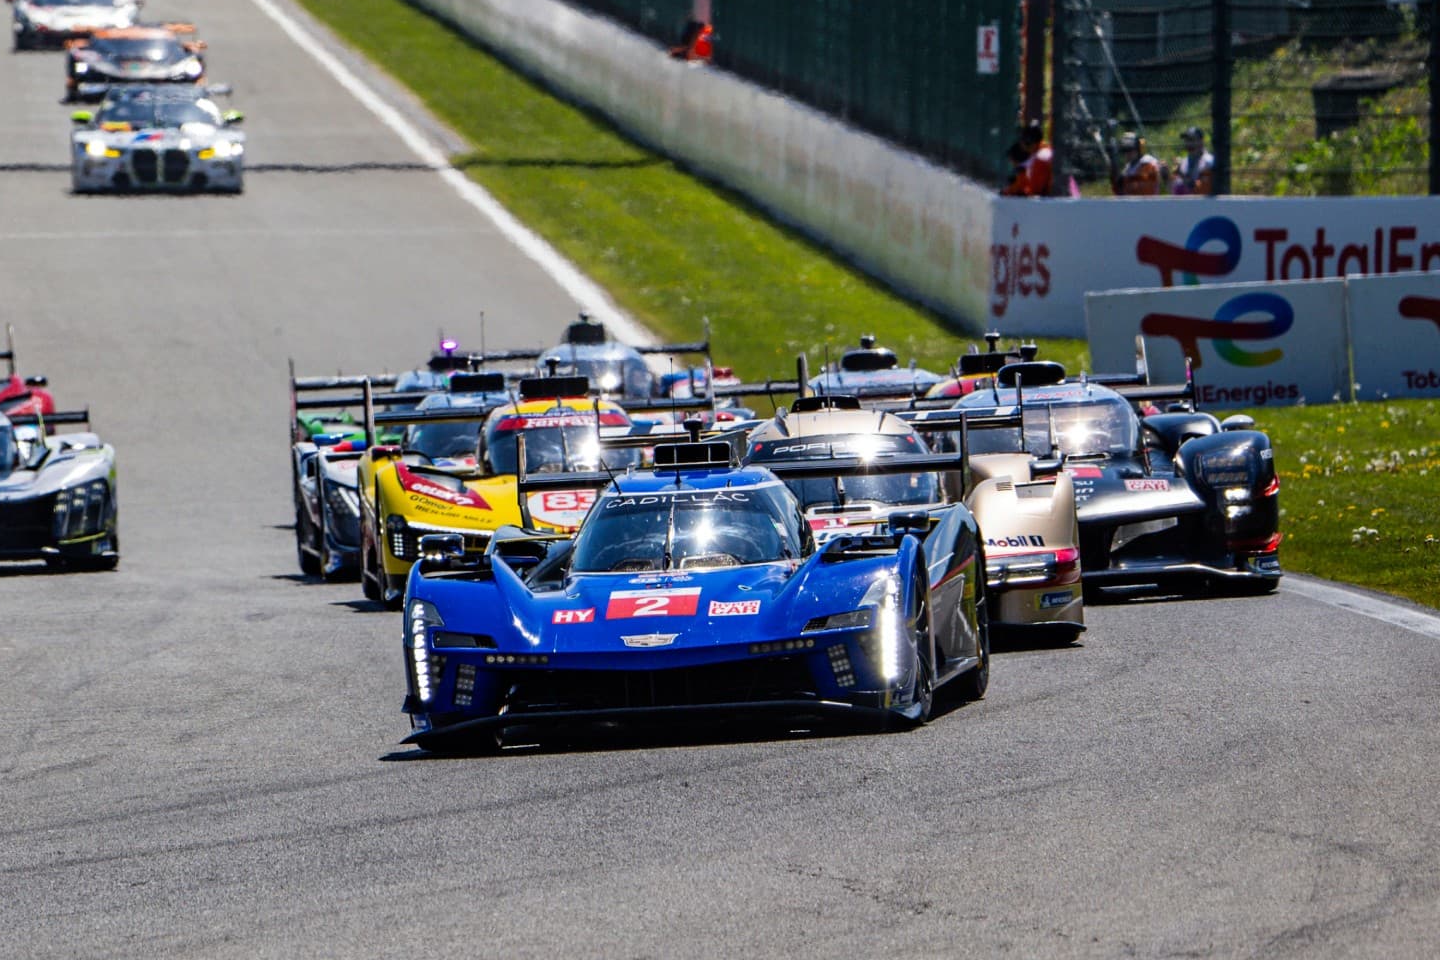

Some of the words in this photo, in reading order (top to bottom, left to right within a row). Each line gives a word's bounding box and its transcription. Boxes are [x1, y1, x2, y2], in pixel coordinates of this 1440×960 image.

[773, 441, 897, 455] PORSE
[546, 493, 596, 511] 83
[606, 491, 750, 510] CADILLAC
[633, 596, 670, 617] 2
[711, 605, 758, 616] CAR
[554, 609, 594, 623] HY
